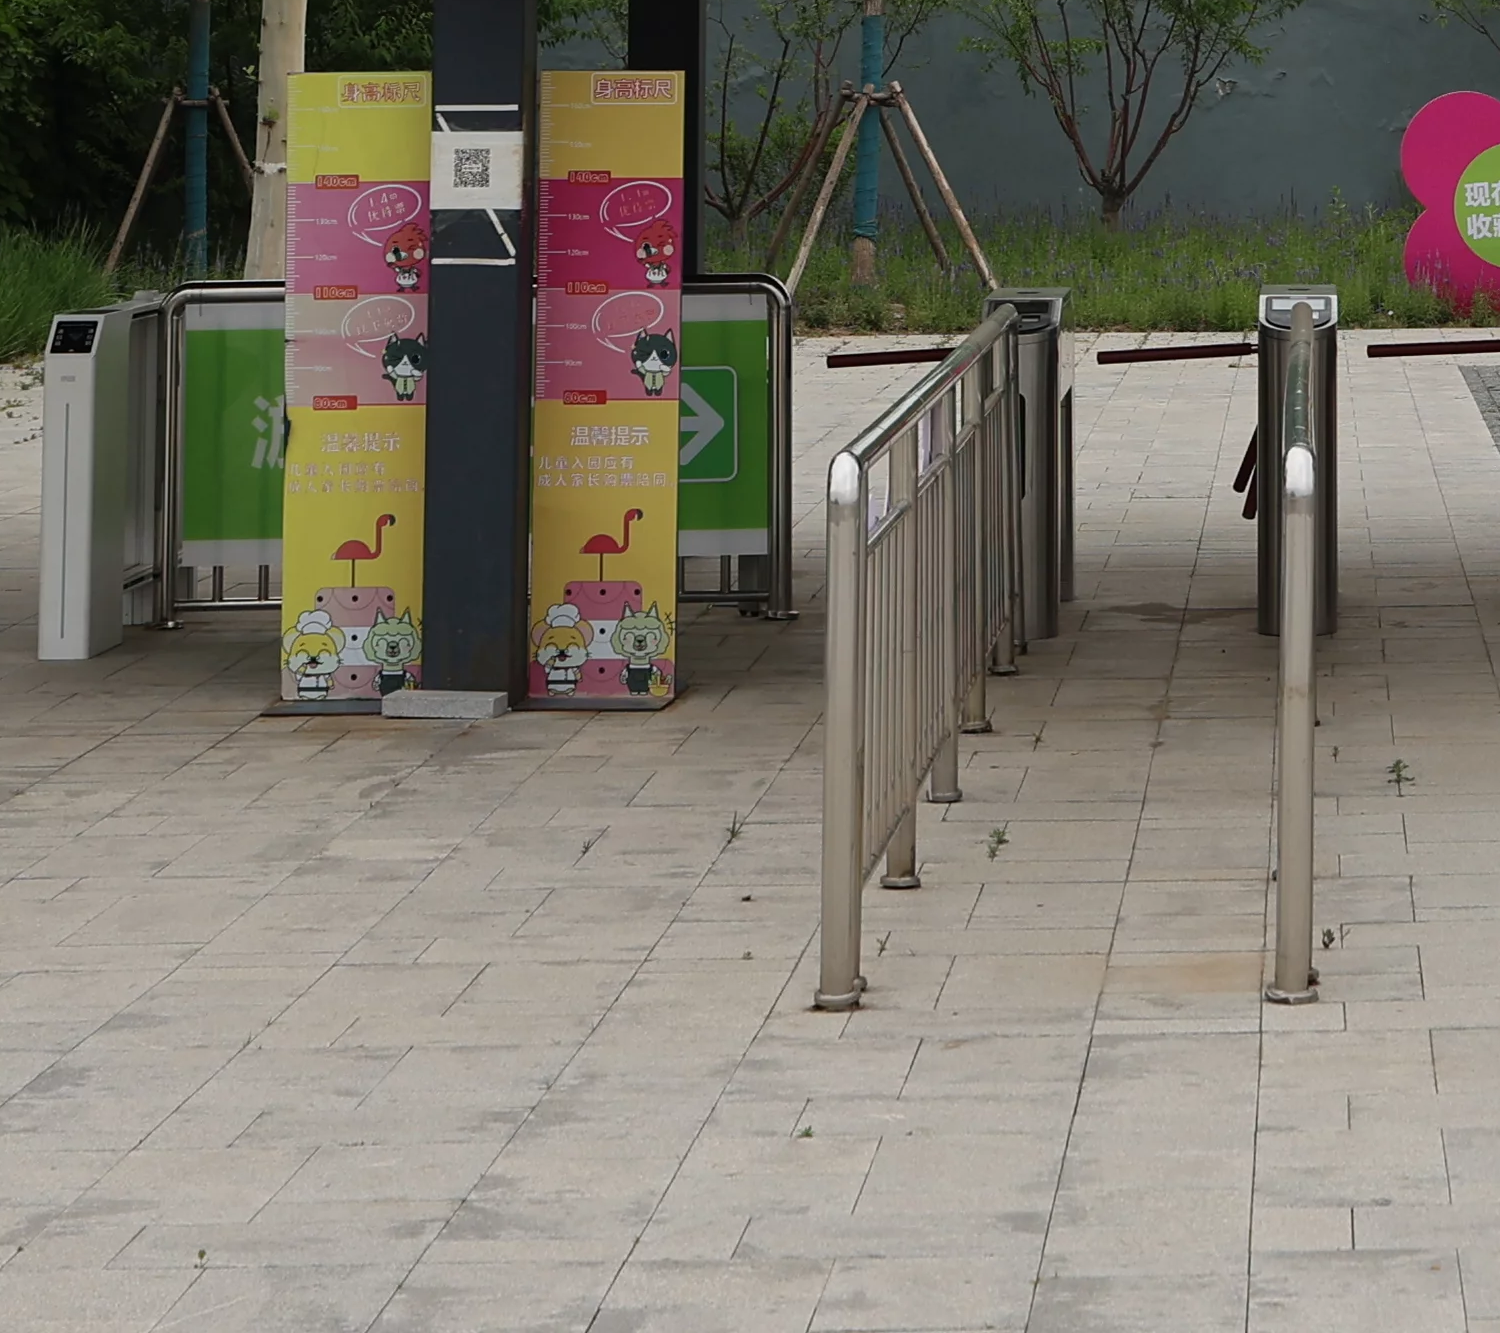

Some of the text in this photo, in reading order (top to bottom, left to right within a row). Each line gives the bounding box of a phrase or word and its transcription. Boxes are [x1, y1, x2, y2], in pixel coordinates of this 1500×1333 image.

[341, 82, 421, 103] 身高标尺
[595, 79, 672, 99] 身高标尺
[317, 176, 358, 188] 140cm
[569, 171, 609, 183] 140cm
[315, 286, 357, 299] 110cm
[567, 282, 607, 293] 110cm
[570, 426, 649, 446] 温馨提示
[538, 456, 634, 470] 儿童入园应有
